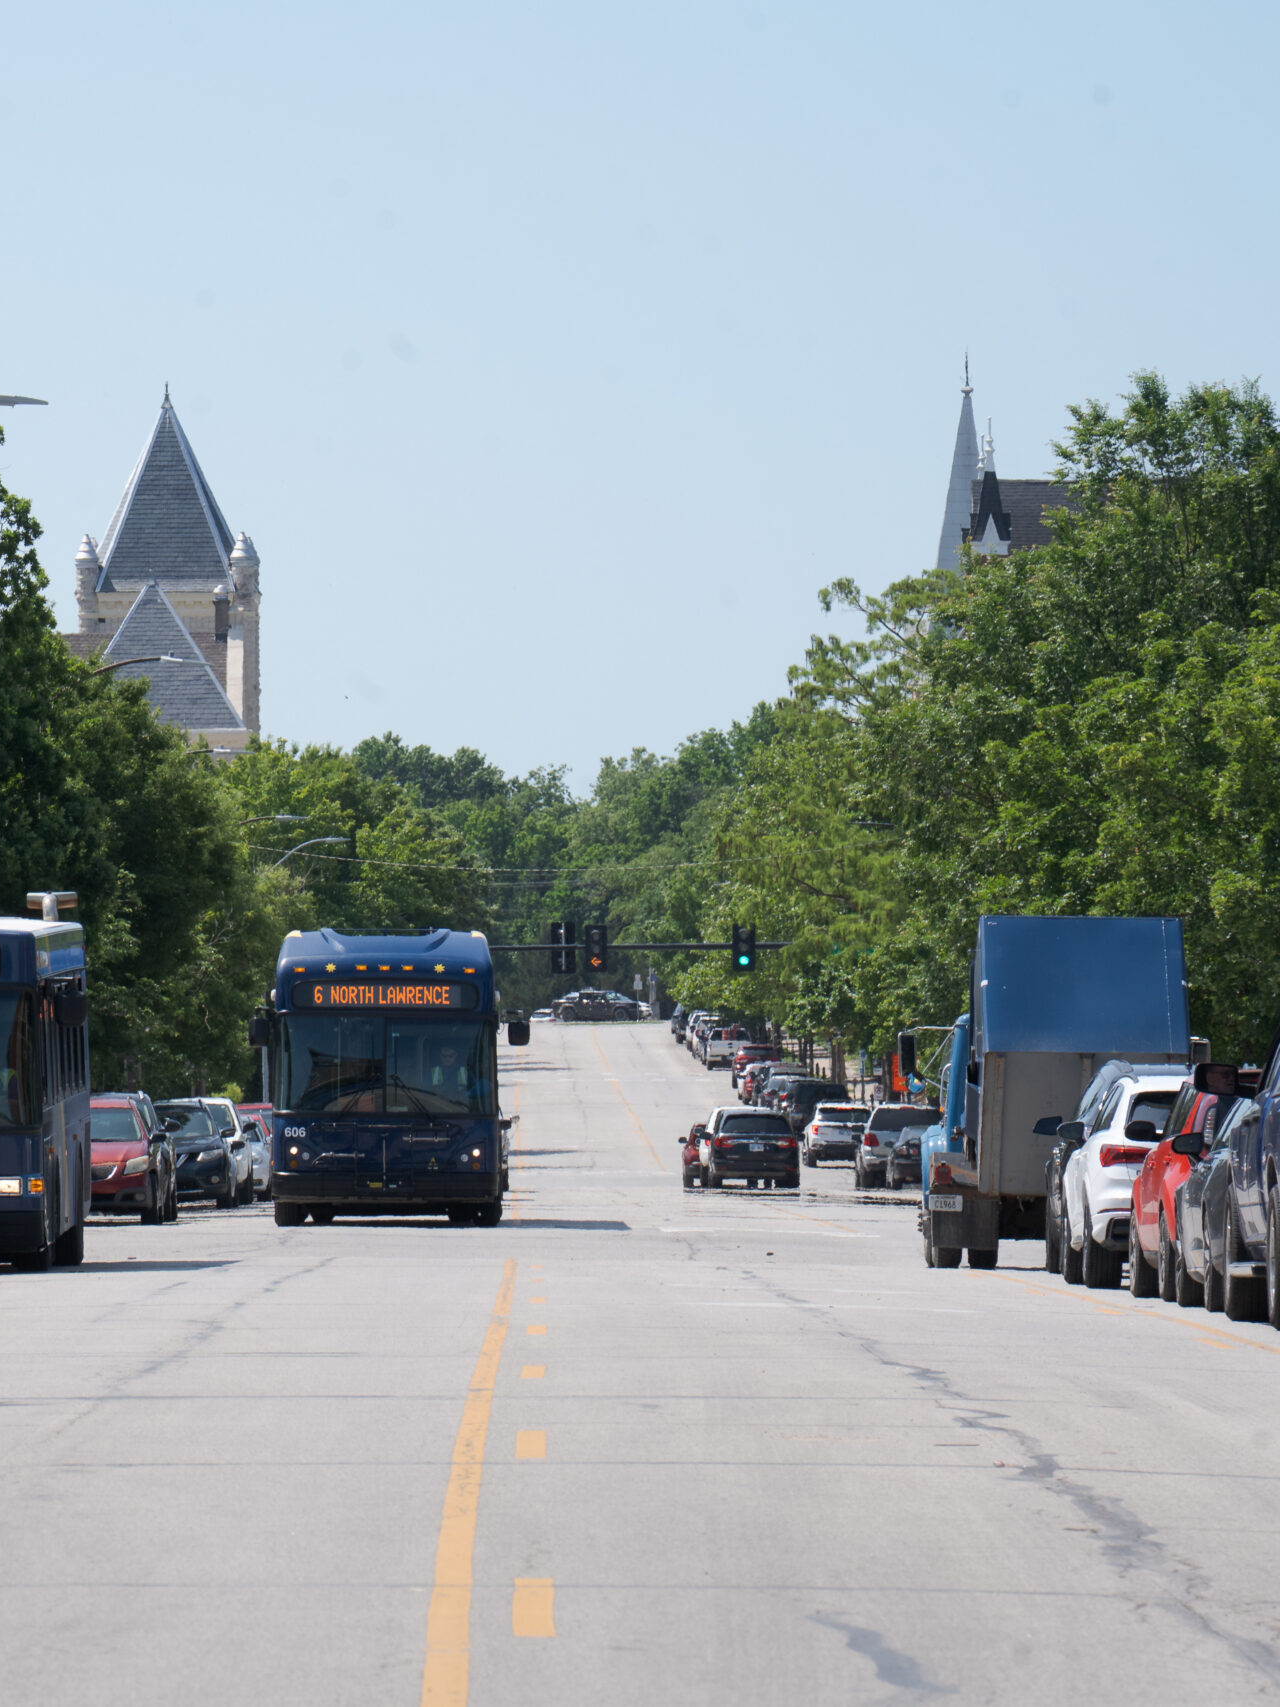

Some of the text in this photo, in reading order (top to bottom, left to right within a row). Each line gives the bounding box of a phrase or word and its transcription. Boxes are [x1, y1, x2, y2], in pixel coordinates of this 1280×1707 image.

[314, 985, 450, 1005] 6 NORTH LAWRENCE
[284, 1126, 306, 1138] 606
